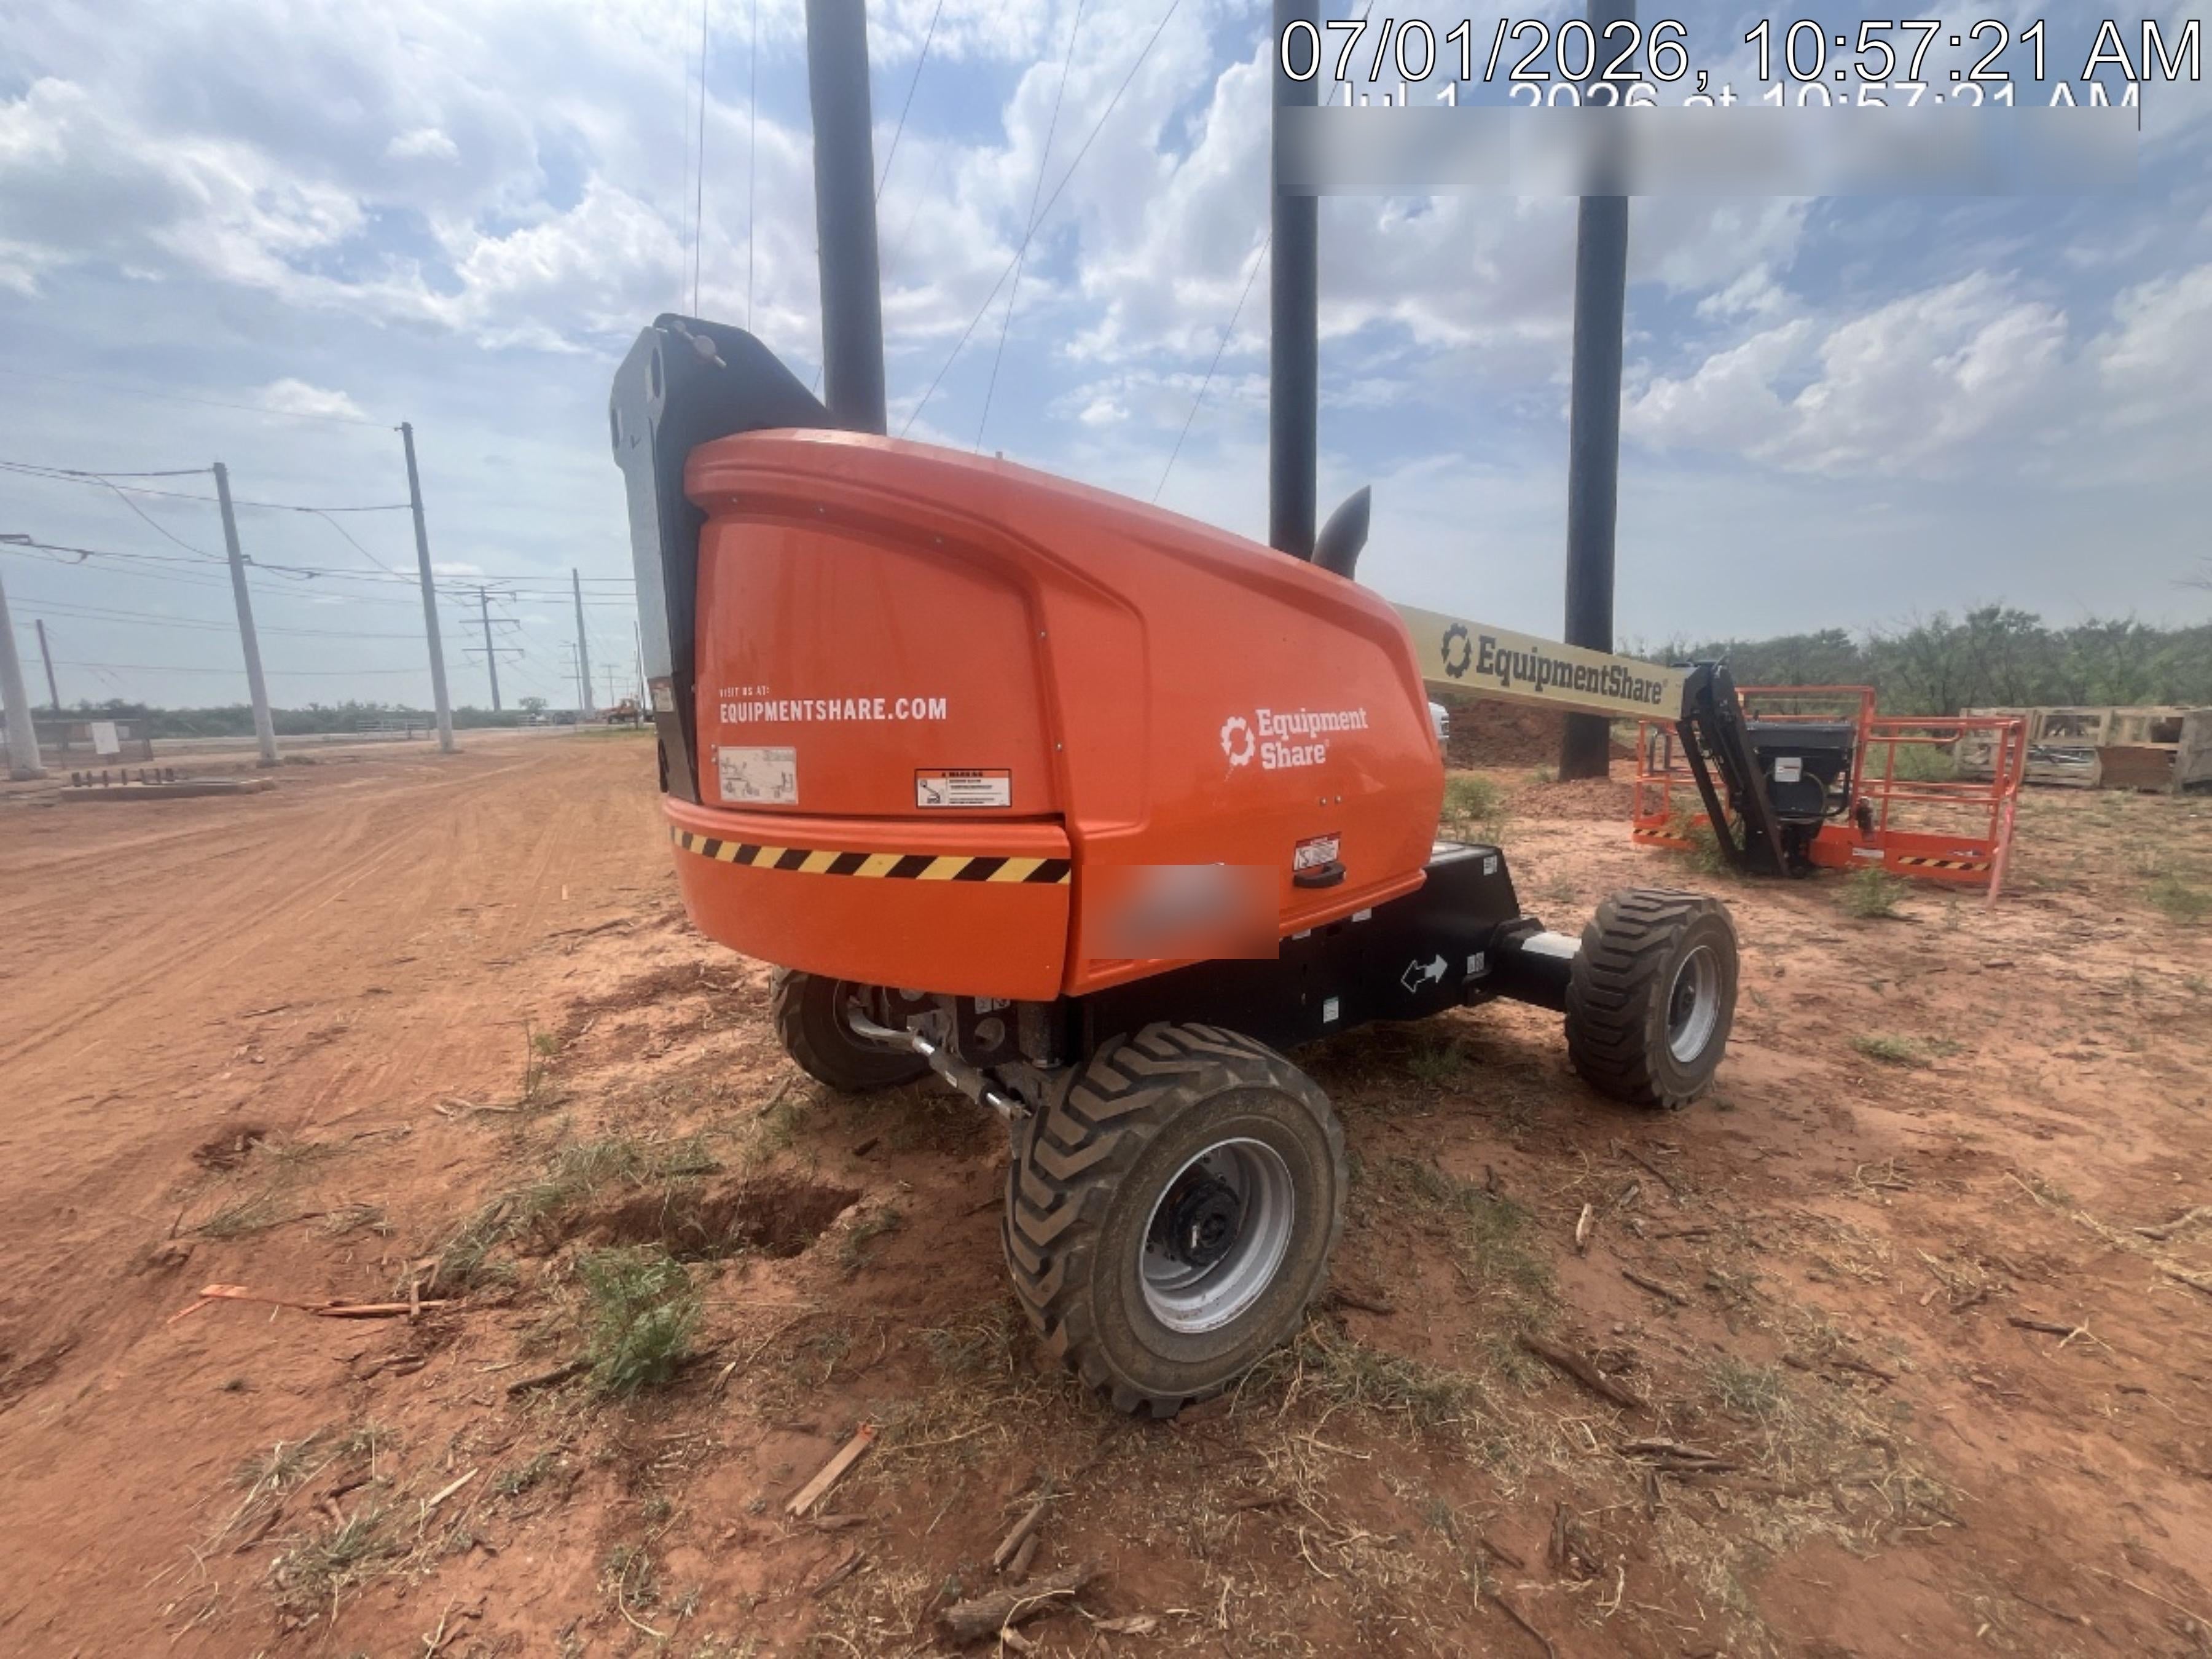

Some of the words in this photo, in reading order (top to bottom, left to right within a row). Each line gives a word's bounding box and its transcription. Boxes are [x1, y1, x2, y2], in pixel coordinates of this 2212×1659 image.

[1475, 635, 1663, 705] EquipmentShare
[720, 697, 947, 724] EQUIPMENTSHARE.COM
[1255, 707, 1369, 740] Equipment
[1261, 741, 1327, 769] Share
